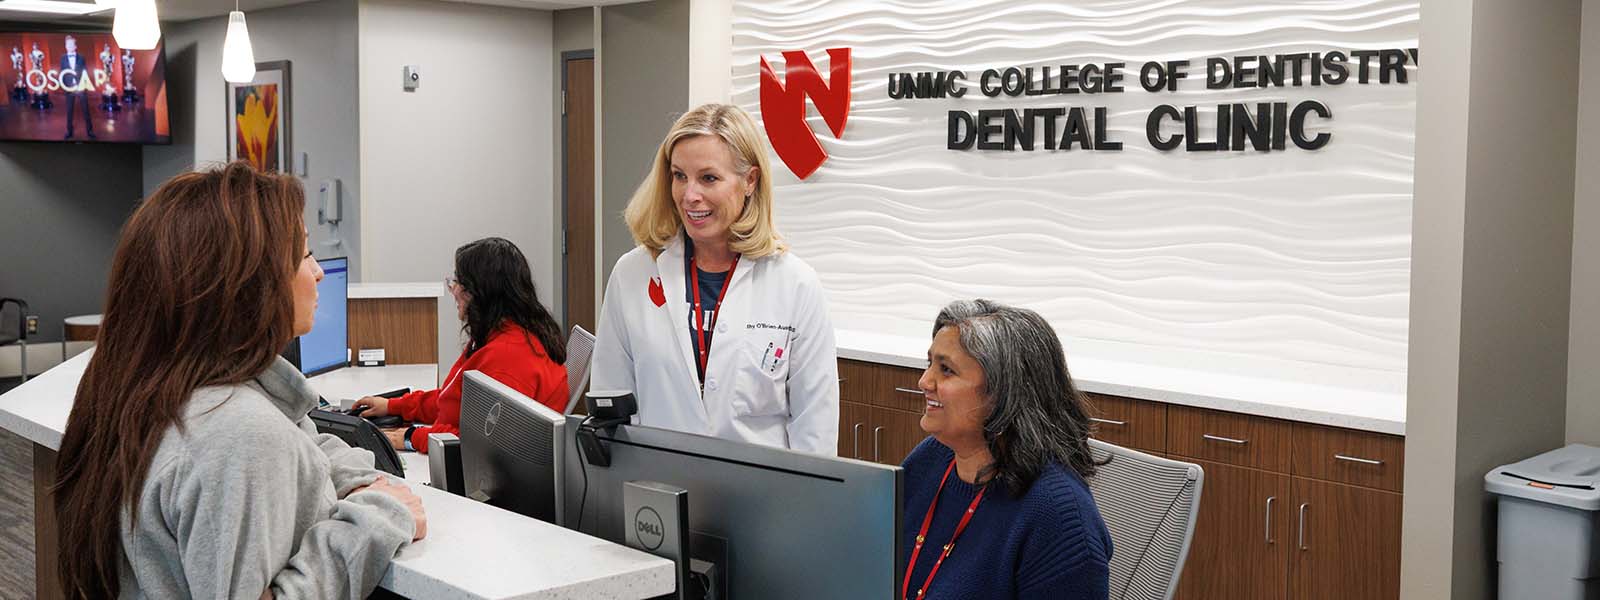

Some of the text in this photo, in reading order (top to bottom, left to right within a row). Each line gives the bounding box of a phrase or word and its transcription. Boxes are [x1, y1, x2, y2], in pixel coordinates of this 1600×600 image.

[887, 70, 968, 99] UNMC
[979, 62, 1125, 97] COLLEGE
[1139, 60, 1190, 92] OF
[946, 100, 1332, 152] DENTAL CLINIC
[638, 521, 661, 537] DELL
